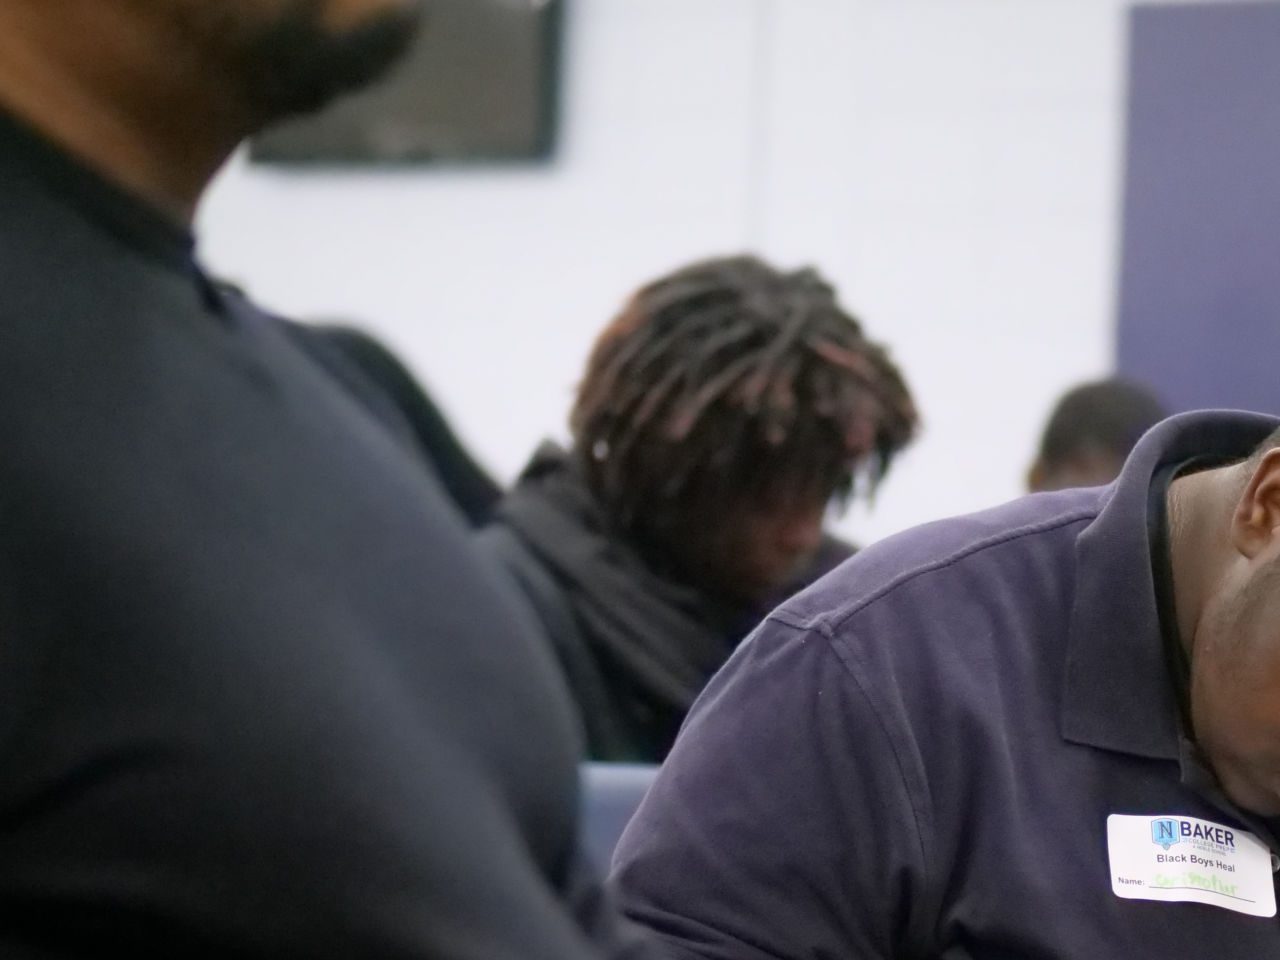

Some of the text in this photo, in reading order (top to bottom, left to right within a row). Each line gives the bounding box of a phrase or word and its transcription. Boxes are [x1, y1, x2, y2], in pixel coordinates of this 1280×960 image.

[1158, 821, 1173, 839] N
[1180, 821, 1235, 847] BAKER
[1157, 854, 1236, 872] Black Boys Heal
[1118, 877, 1145, 886] Name:
